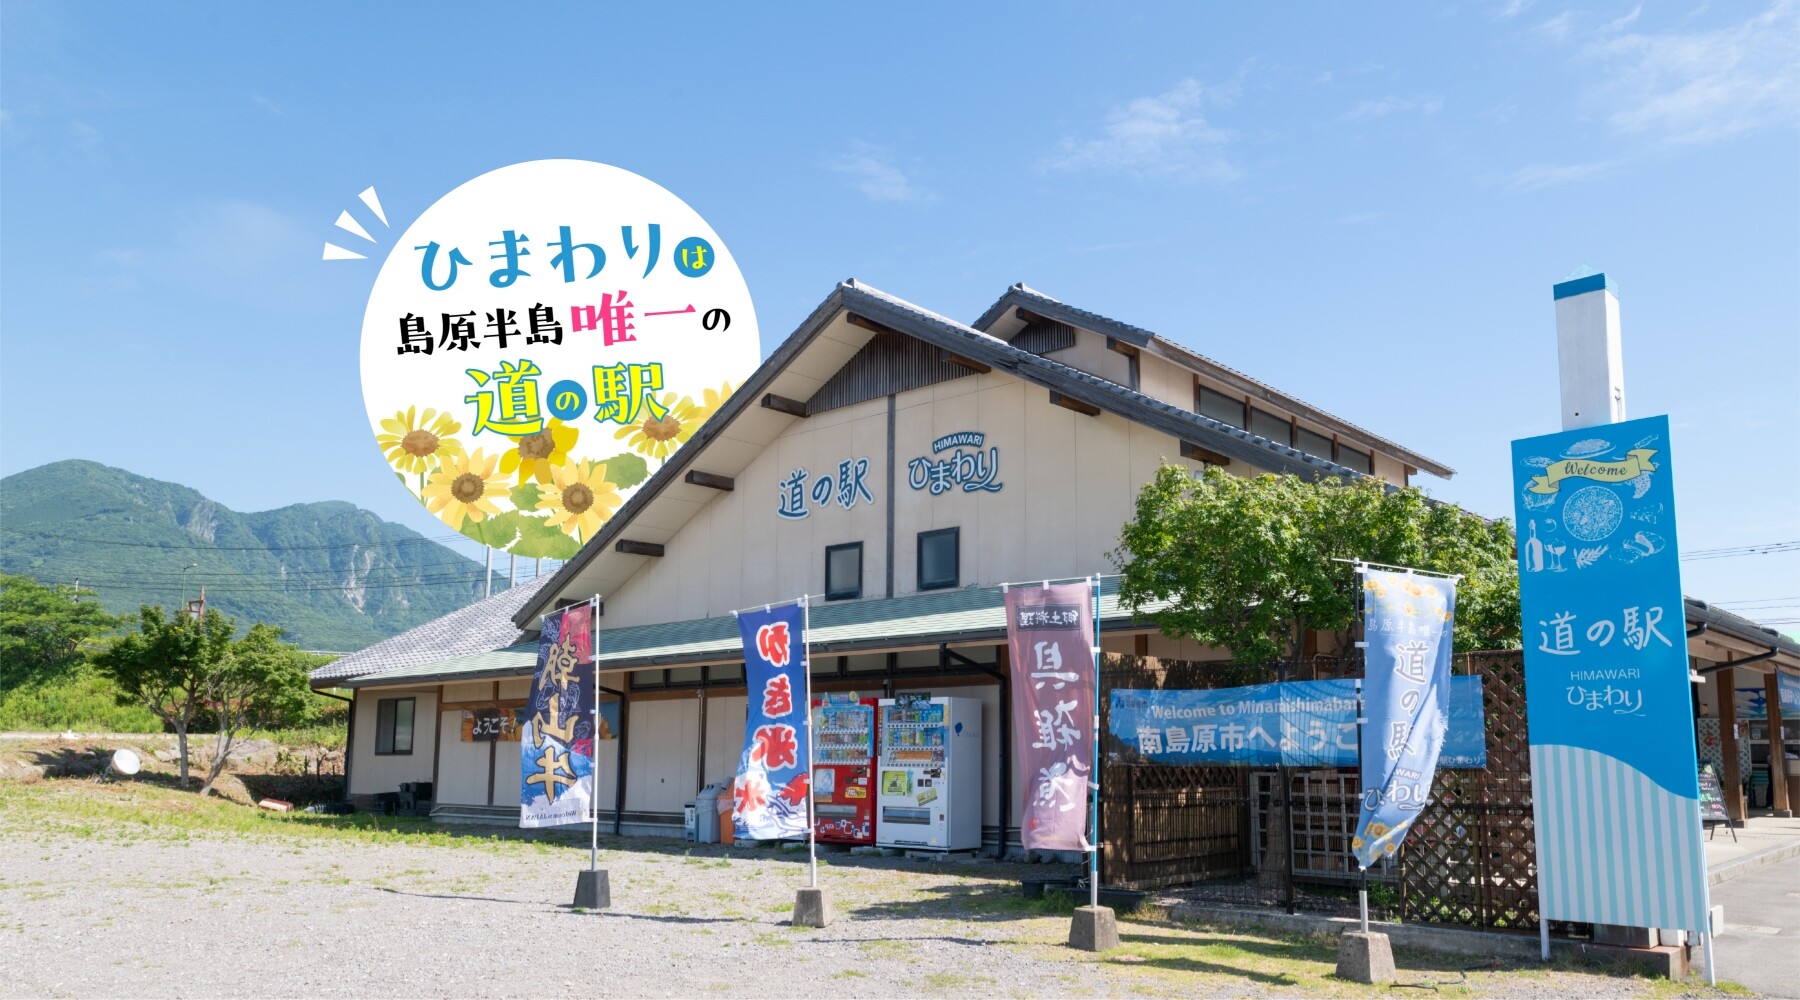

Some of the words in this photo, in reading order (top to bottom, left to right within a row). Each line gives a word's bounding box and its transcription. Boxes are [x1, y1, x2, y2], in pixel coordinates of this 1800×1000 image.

[933, 433, 984, 453] HIMAWARI
[909, 447, 1003, 495] ひまわり
[1564, 460, 1628, 477] Welcome
[777, 457, 874, 520] 道の駅
[1538, 606, 1672, 656] 道の駅
[1570, 668, 1641, 681] HIMAWARI
[1151, 705, 1216, 720] Welcome
[1219, 703, 1236, 716] to
[1566, 685, 1646, 716] ひまわり
